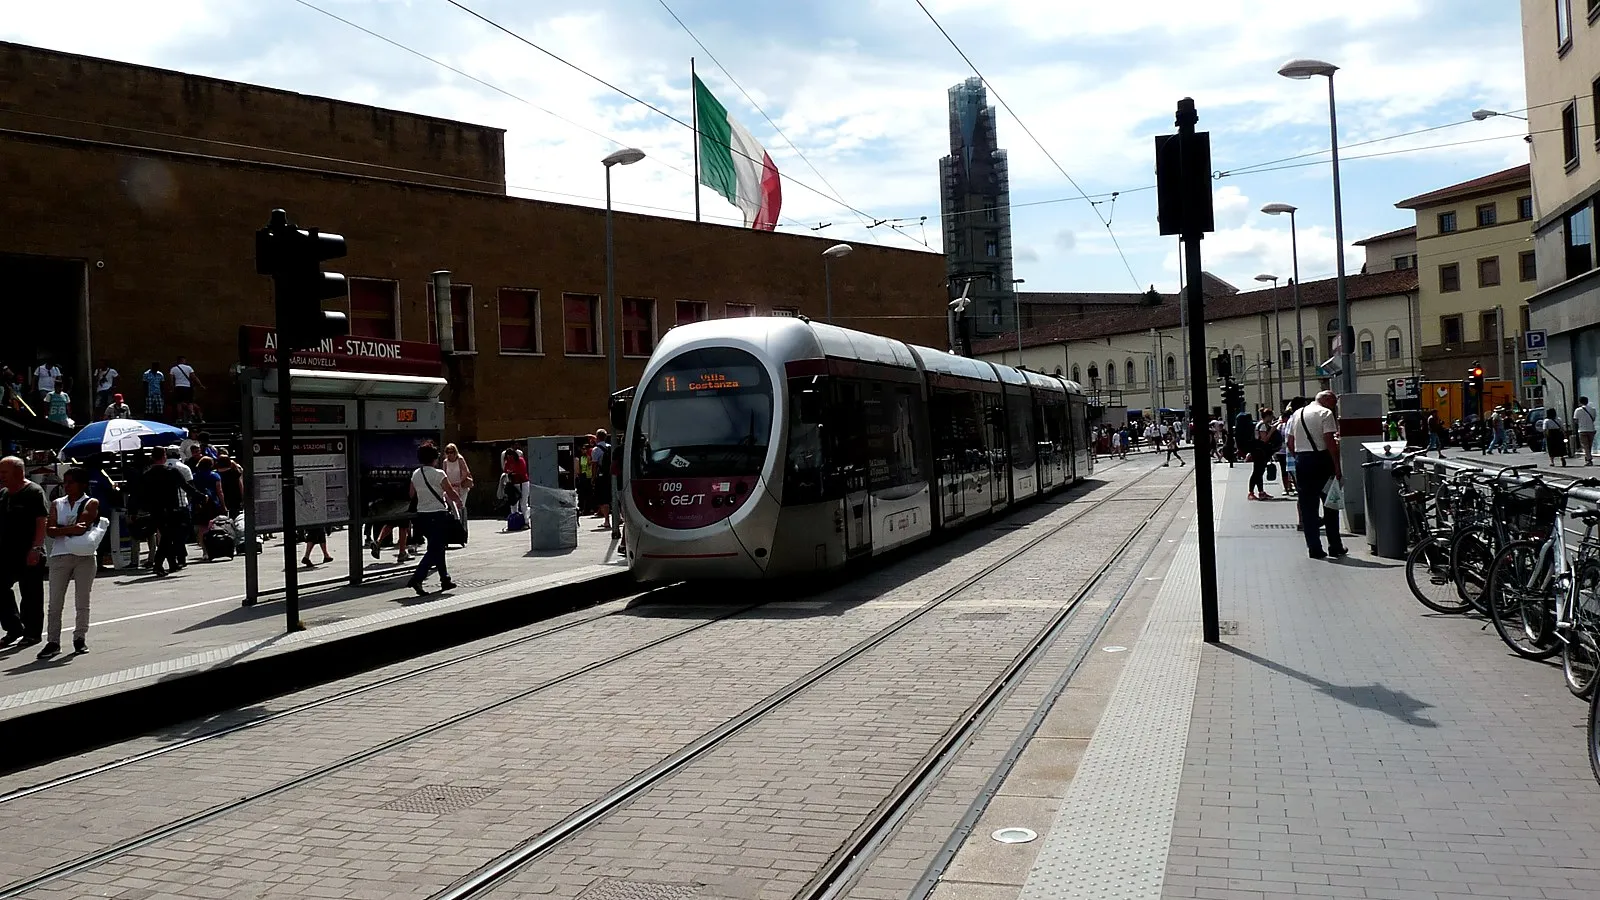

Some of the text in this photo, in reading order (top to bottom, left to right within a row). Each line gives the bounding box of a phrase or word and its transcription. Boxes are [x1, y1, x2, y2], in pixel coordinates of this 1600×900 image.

[1531, 334, 1541, 347] P
[345, 339, 402, 359] STAZIONE
[308, 357, 337, 368] NOVELLA
[665, 375, 676, 391] T1
[700, 373, 726, 382] Villa
[688, 381, 739, 391] Costanza
[657, 482, 683, 492] 1009
[670, 494, 706, 506] GEST
